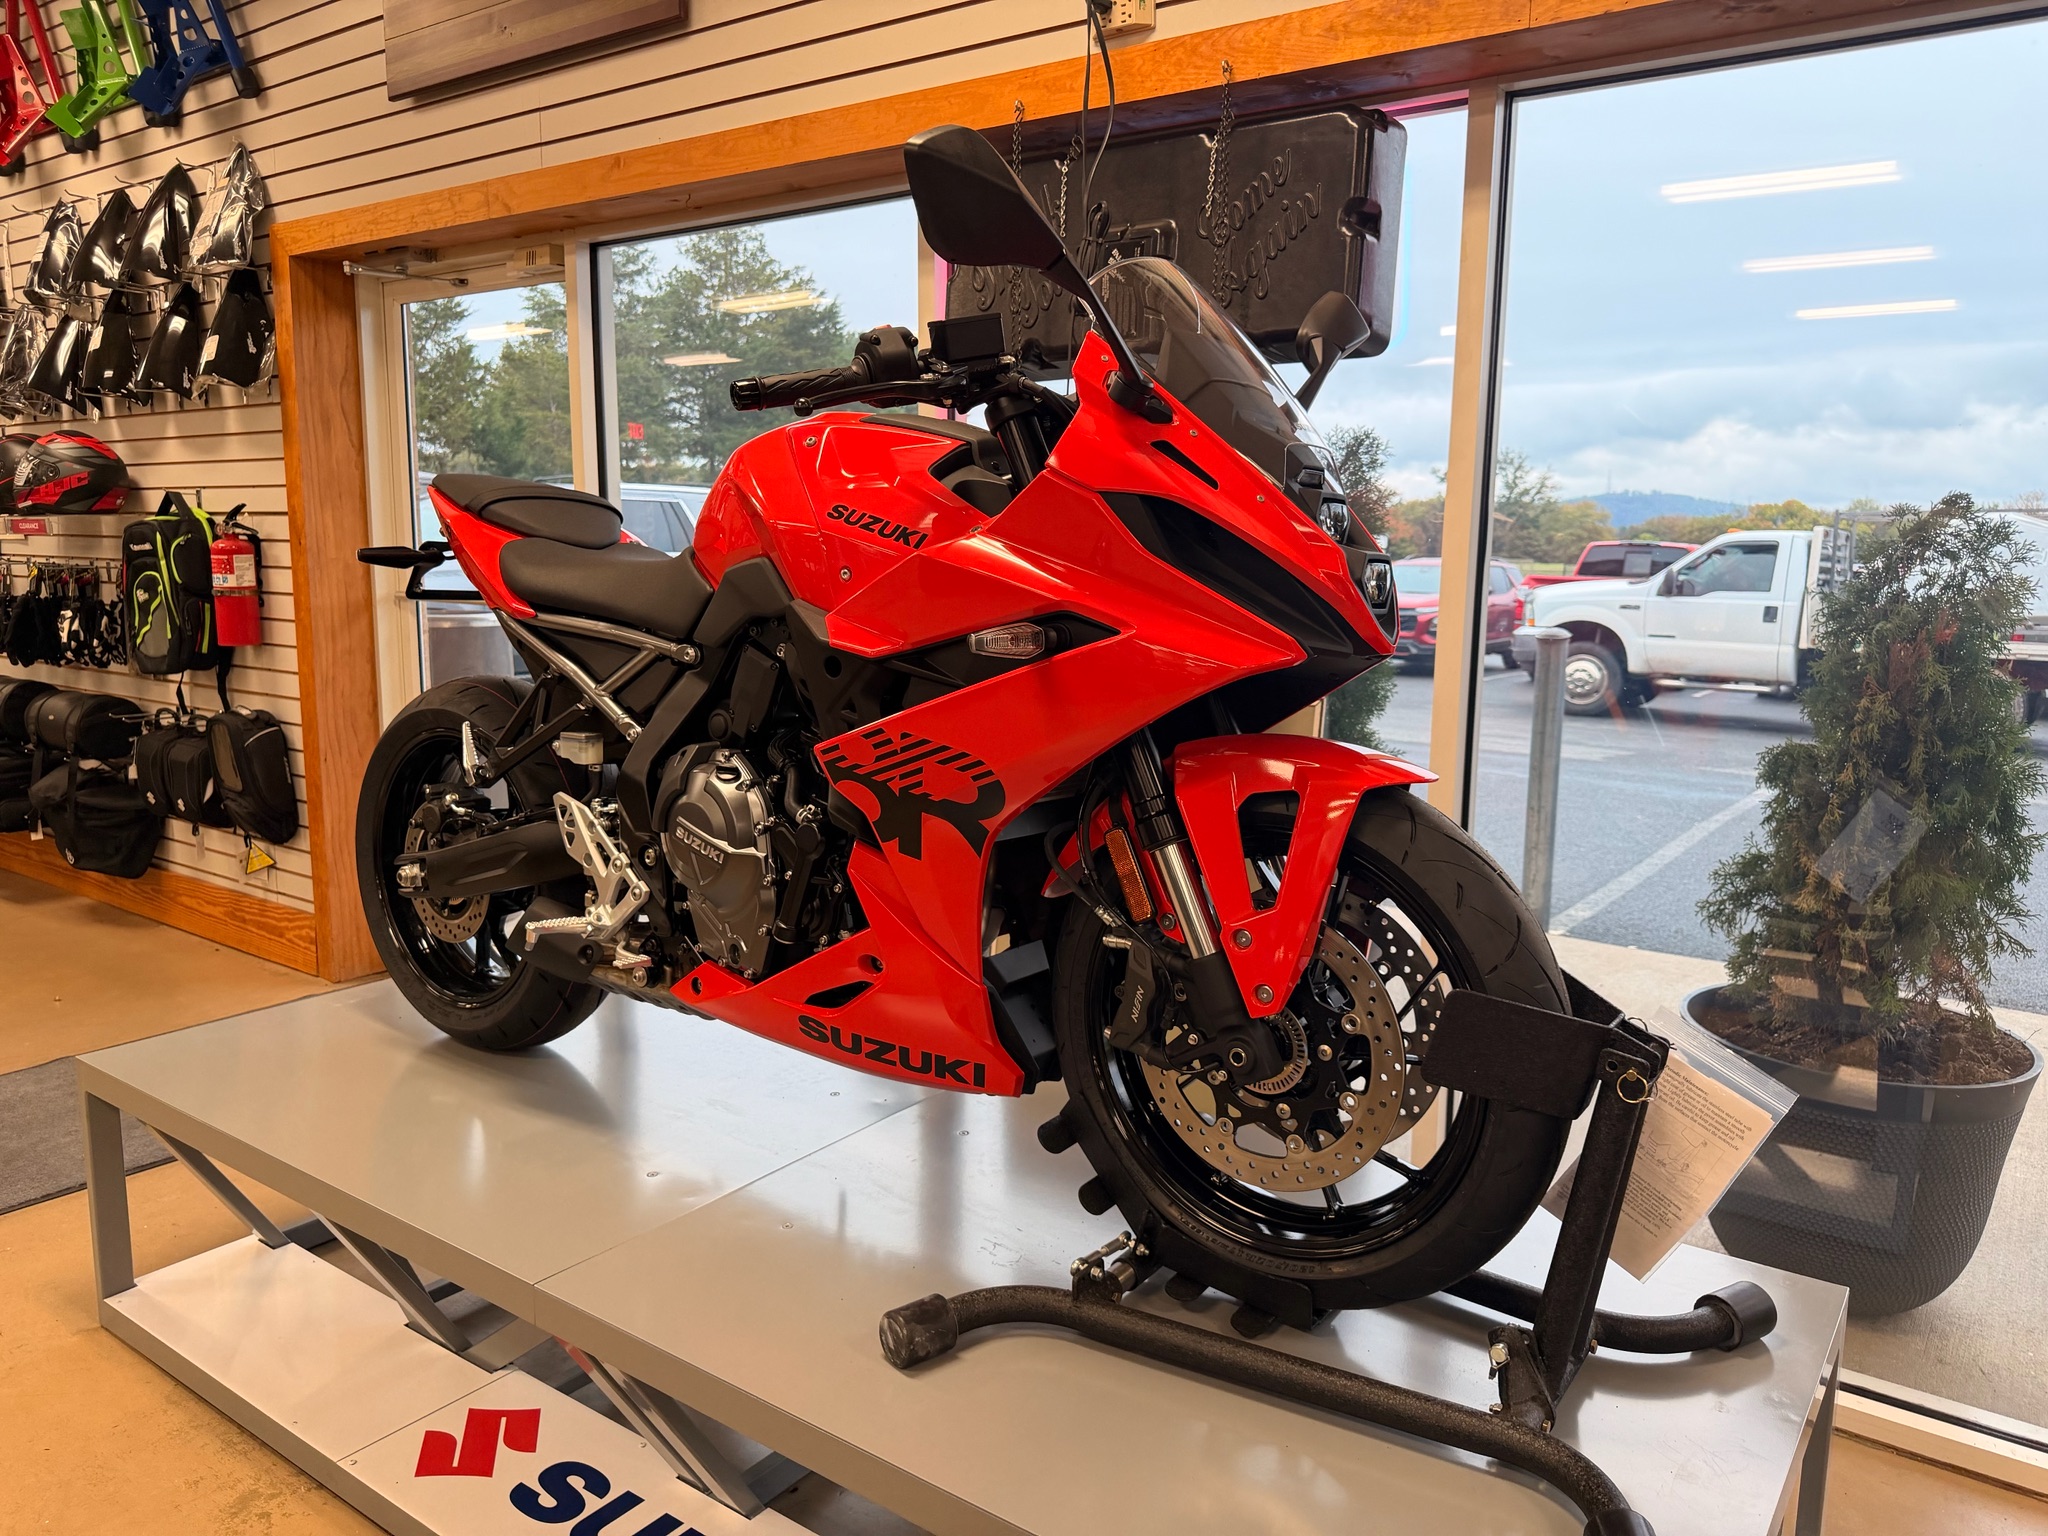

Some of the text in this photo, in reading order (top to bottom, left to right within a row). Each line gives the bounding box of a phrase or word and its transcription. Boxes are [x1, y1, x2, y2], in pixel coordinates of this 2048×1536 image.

[826, 504, 929, 550] SUZUKI
[675, 826, 725, 864] SUZUKI
[798, 1014, 986, 1089] SUZUKI
[509, 1461, 706, 1536] SU
